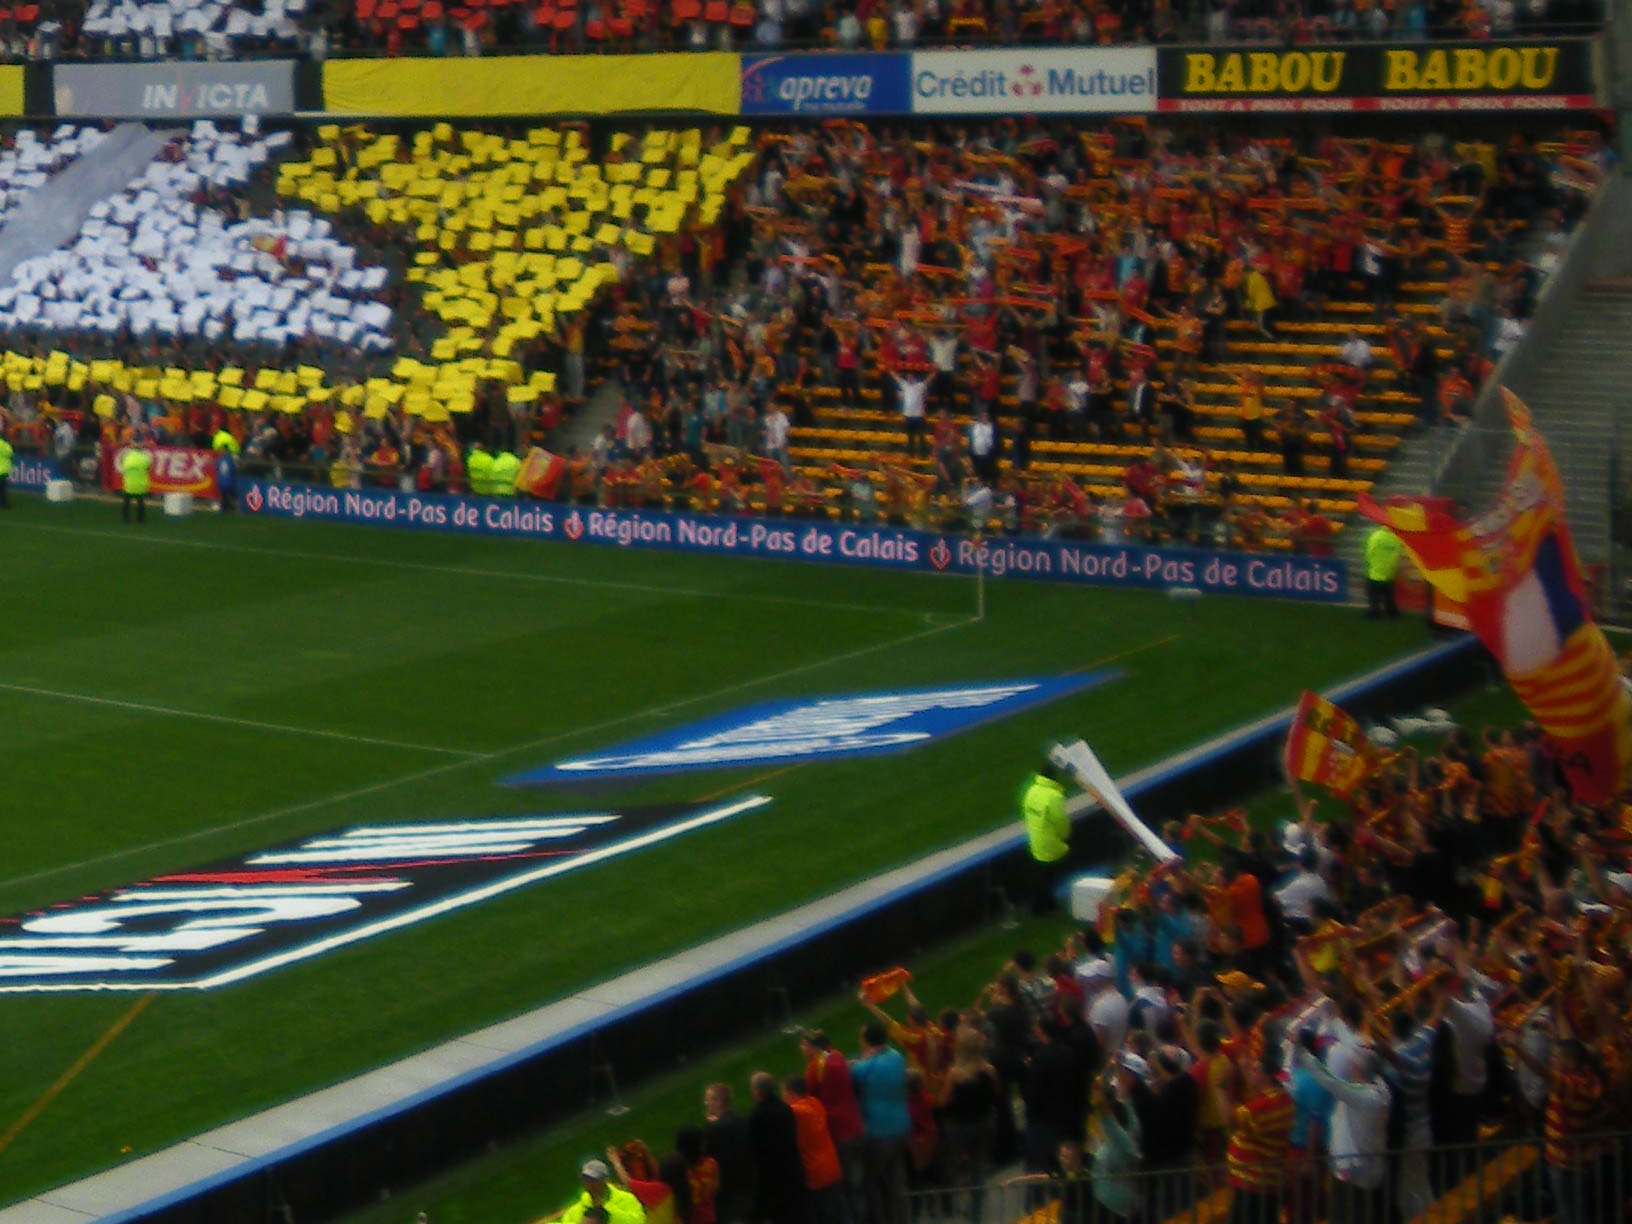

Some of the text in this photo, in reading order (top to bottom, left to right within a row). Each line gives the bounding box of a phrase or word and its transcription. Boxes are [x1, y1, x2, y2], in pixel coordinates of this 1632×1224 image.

[916, 68, 1155, 98] Crédit Mutuel
[1183, 51, 1345, 92] BABOU
[1383, 47, 1559, 90] BABOU
[141, 74, 268, 110] INVICTA
[13, 461, 51, 485] alais
[268, 486, 554, 533] Région Nord-Pas de Calais
[589, 513, 918, 562] Région Nord-Pas de Calais
[957, 540, 1338, 593] Région Nord-Pas de Calais
